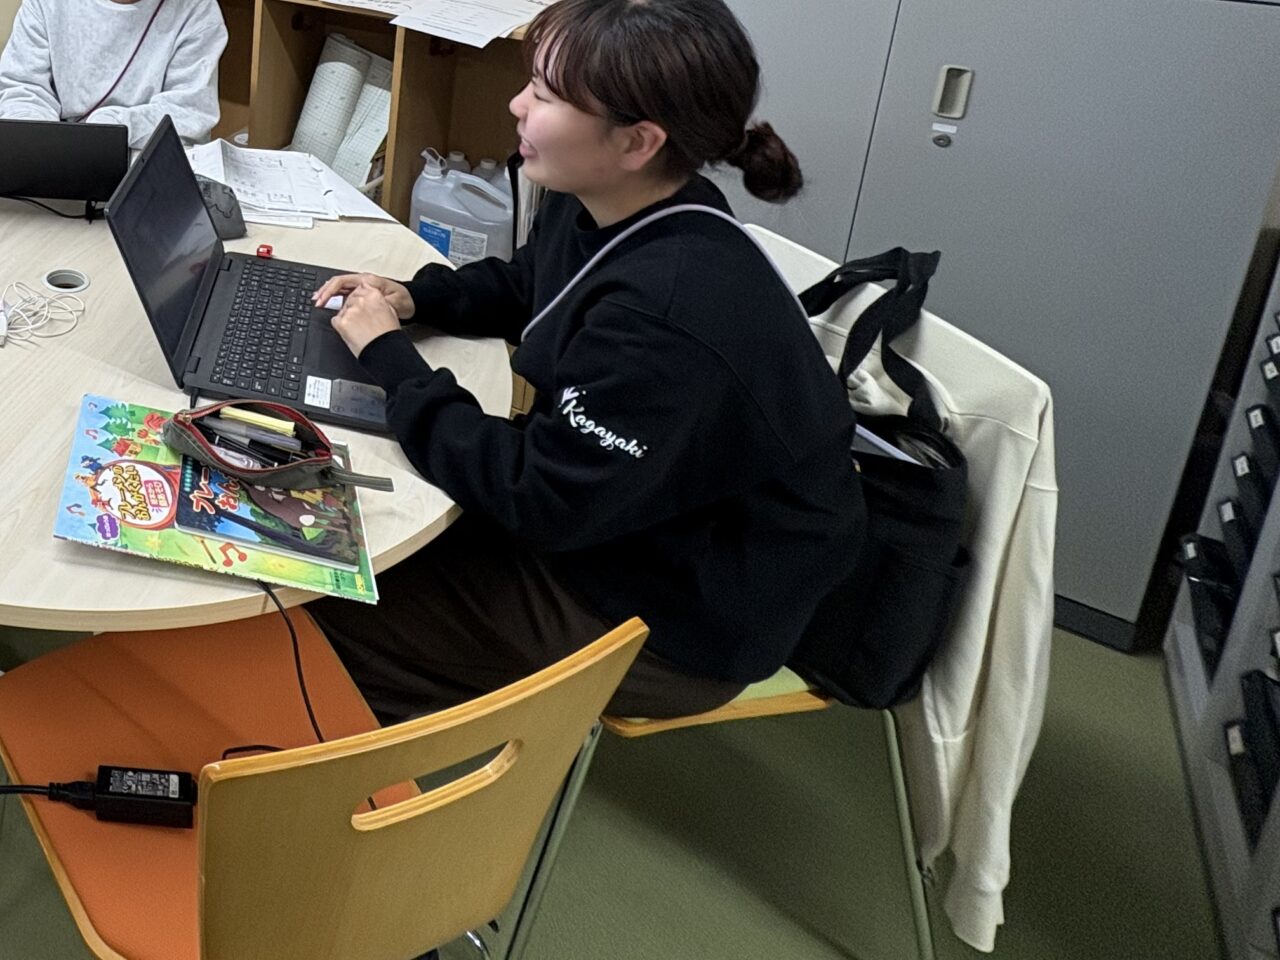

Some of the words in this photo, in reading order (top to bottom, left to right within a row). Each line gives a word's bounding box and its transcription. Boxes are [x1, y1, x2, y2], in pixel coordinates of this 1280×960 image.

[562, 399, 648, 459] Kagayaki
[189, 466, 215, 514] ブレー
[215, 478, 240, 511] おん
